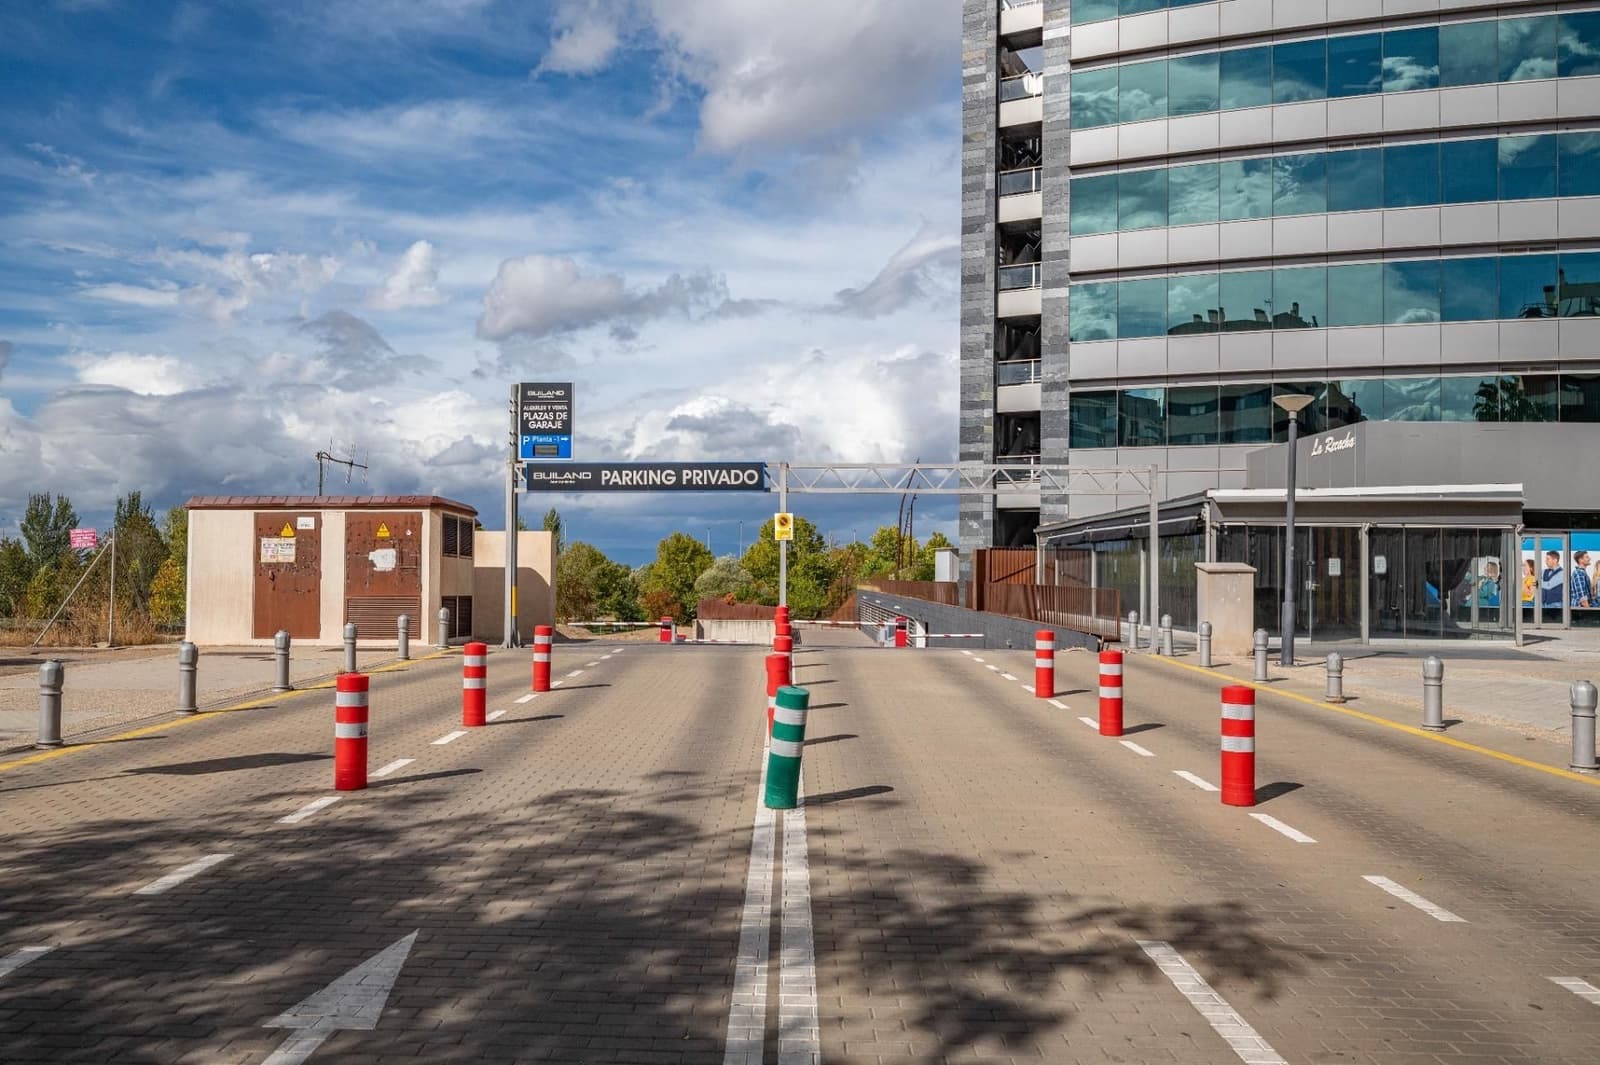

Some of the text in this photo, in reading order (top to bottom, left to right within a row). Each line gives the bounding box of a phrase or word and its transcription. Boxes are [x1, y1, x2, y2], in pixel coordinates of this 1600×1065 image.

[523, 411, 568, 420] PLAZAS DE
[528, 420, 563, 429] GARAJE
[533, 469, 759, 486] BUILAND PARKING PRIVADO
